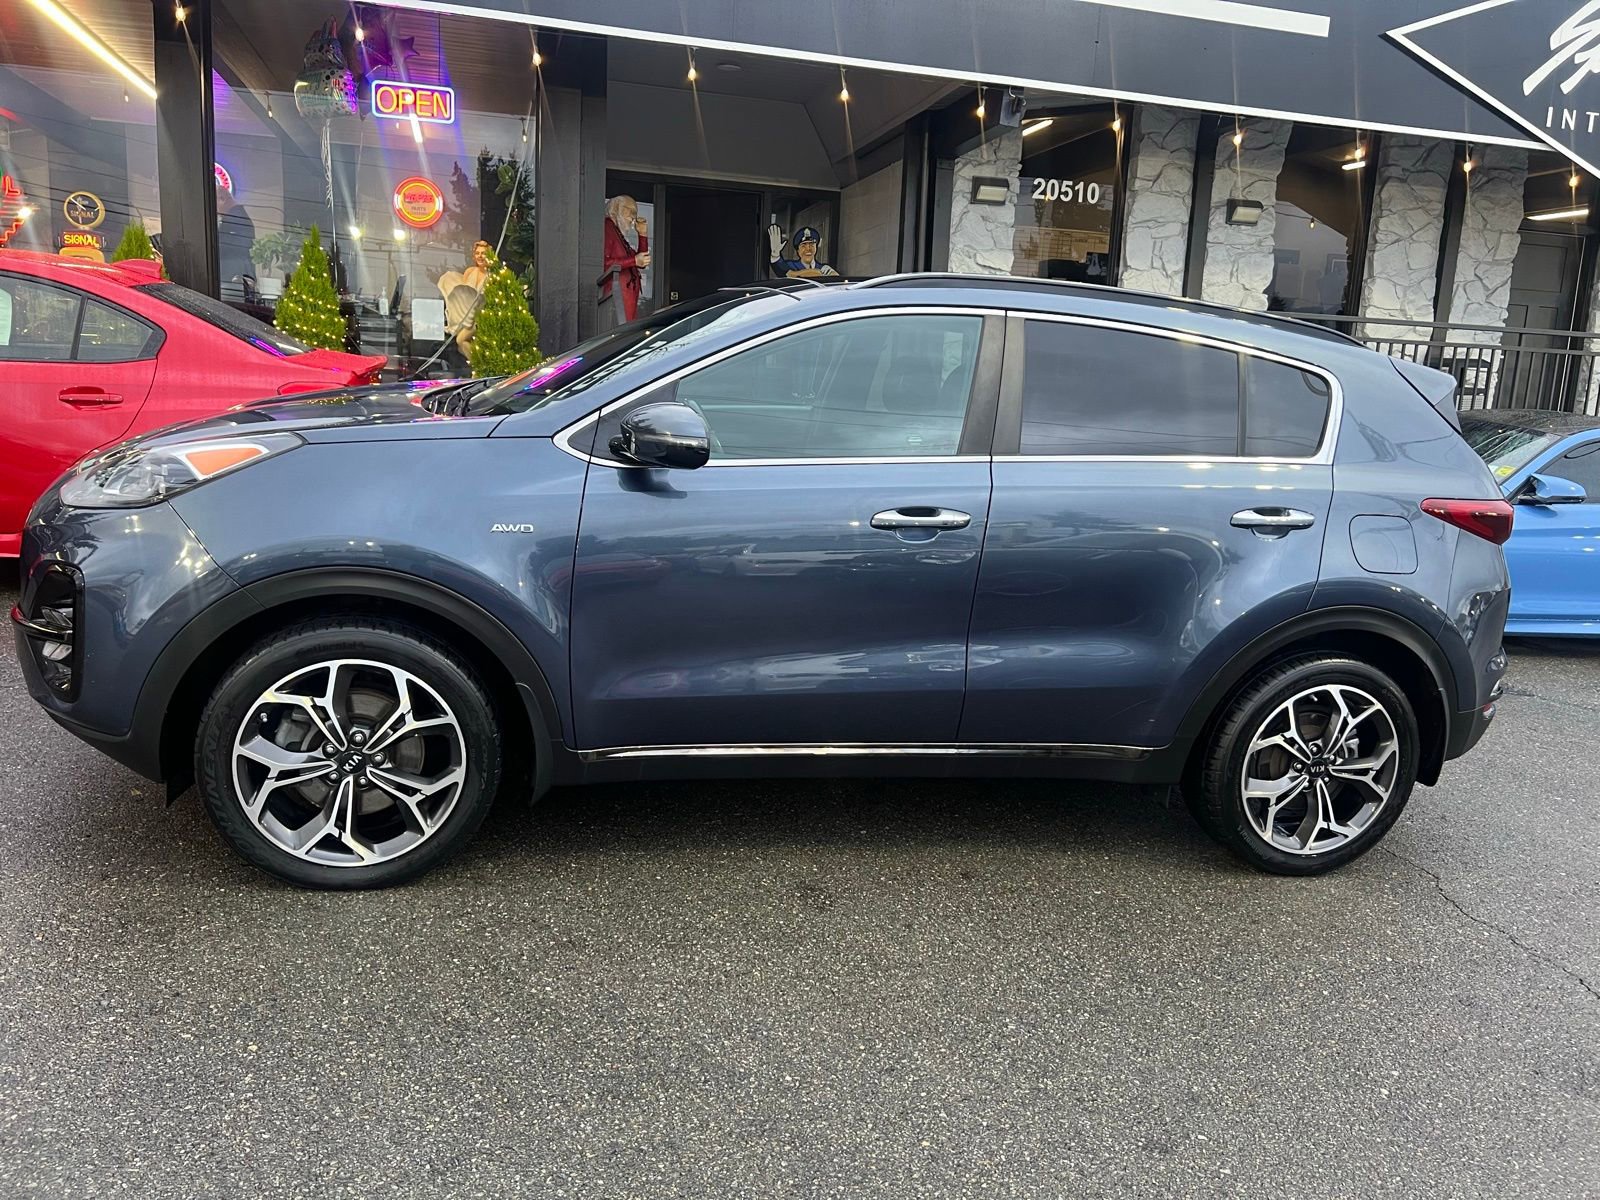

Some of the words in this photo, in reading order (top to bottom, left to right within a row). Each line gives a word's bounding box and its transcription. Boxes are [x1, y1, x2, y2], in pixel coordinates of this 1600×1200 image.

[376, 86, 451, 118] OPEN
[1032, 178, 1100, 204] 20510
[63, 234, 100, 248] SIGNAL
[490, 523, 534, 533] AWD
[343, 755, 362, 771] KIA
